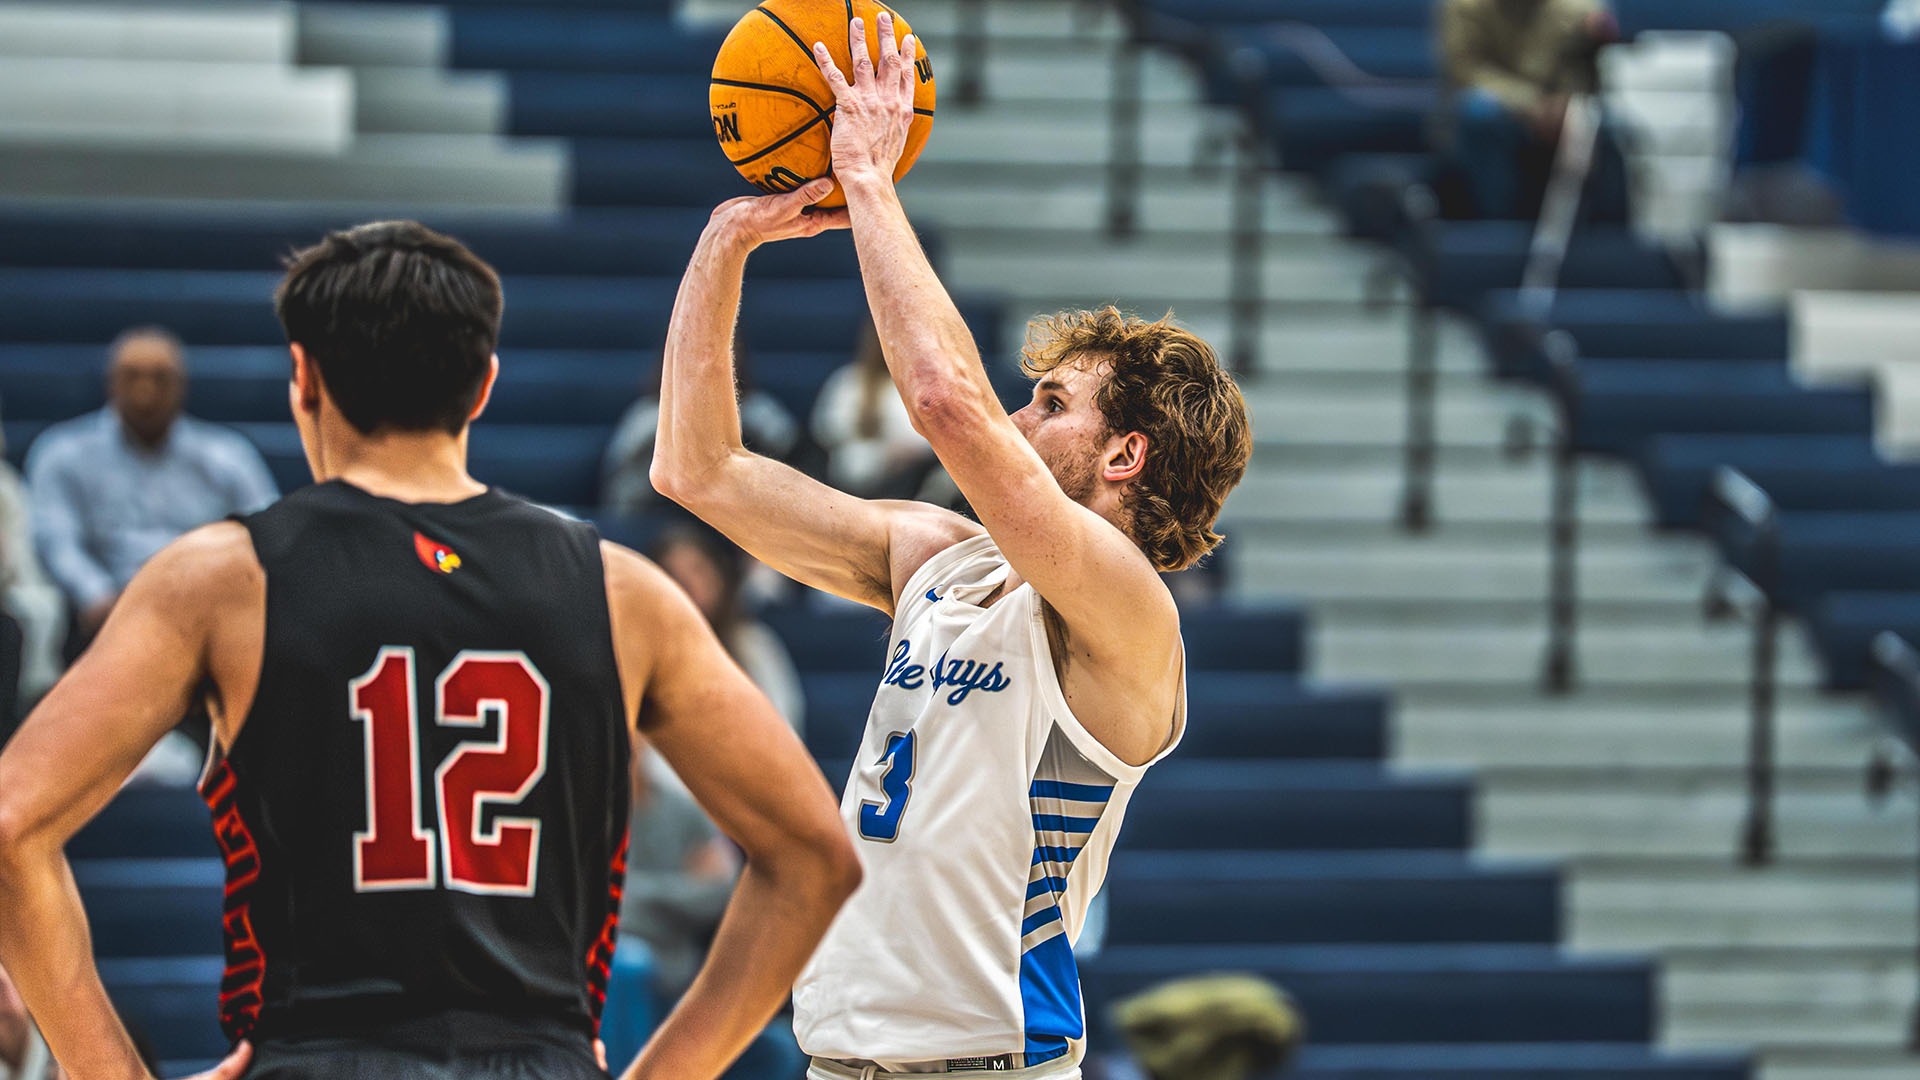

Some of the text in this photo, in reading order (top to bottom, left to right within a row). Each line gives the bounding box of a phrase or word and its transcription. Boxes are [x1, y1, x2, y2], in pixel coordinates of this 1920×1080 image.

[349, 645, 550, 896] 12
[857, 727, 917, 843] 3
[993, 1059, 1005, 1071] M
